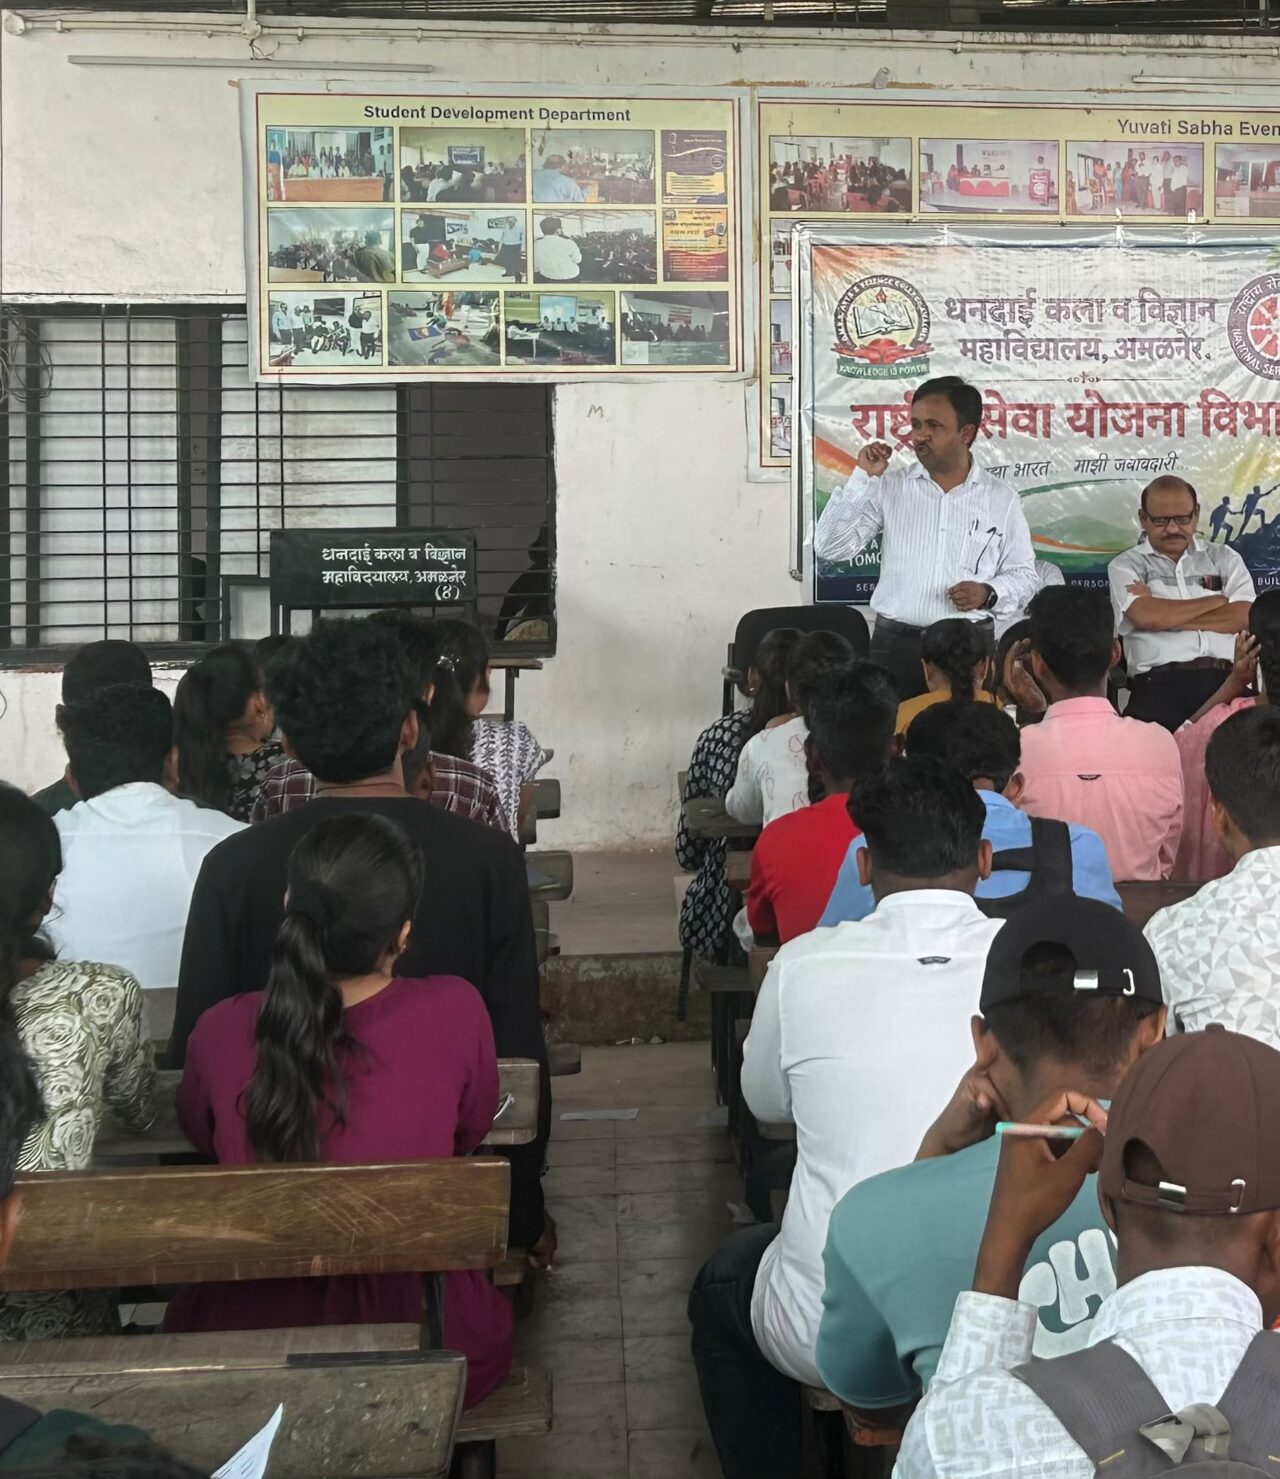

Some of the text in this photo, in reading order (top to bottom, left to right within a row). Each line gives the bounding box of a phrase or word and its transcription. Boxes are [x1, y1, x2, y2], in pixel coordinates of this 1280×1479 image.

[364, 105, 632, 123] Student Development Department
[1117, 119, 1172, 135] Yuvati
[1177, 120, 1233, 135] Sabha
[944, 287, 1219, 328] धनदाई कला व विज्ञान
[958, 328, 1109, 364] महाविद्यालय,
[980, 389, 1053, 439] सेवा
[1066, 389, 1190, 440] योजना
[1074, 452, 1109, 475] माझी
[322, 542, 467, 566] धनदाई कला व विज्ञान
[414, 564, 467, 587] अमळनेर
